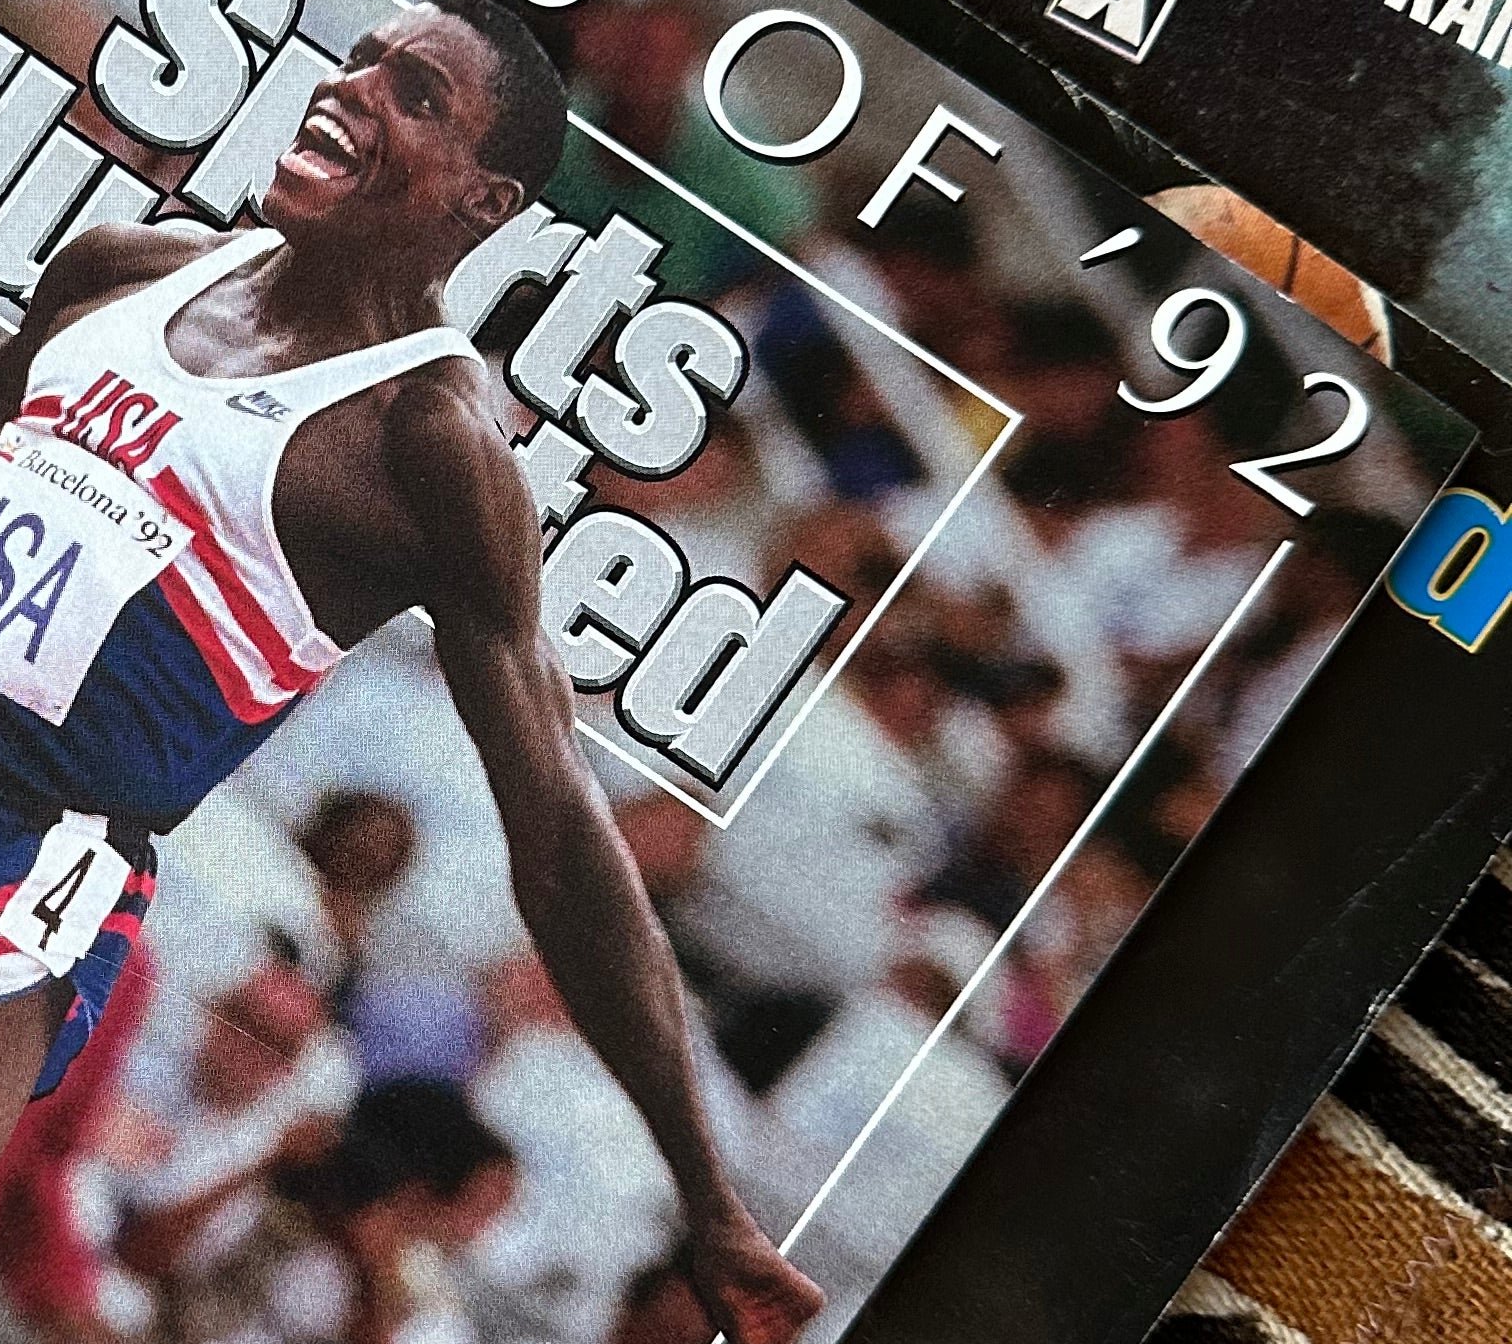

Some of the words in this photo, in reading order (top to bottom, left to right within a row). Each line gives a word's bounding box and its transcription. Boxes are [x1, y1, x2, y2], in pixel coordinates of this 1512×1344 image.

[704, 9, 1003, 229] OF
[58, 368, 185, 478] USA
[17, 449, 126, 527] Barcelona
[31, 847, 96, 951] 4
